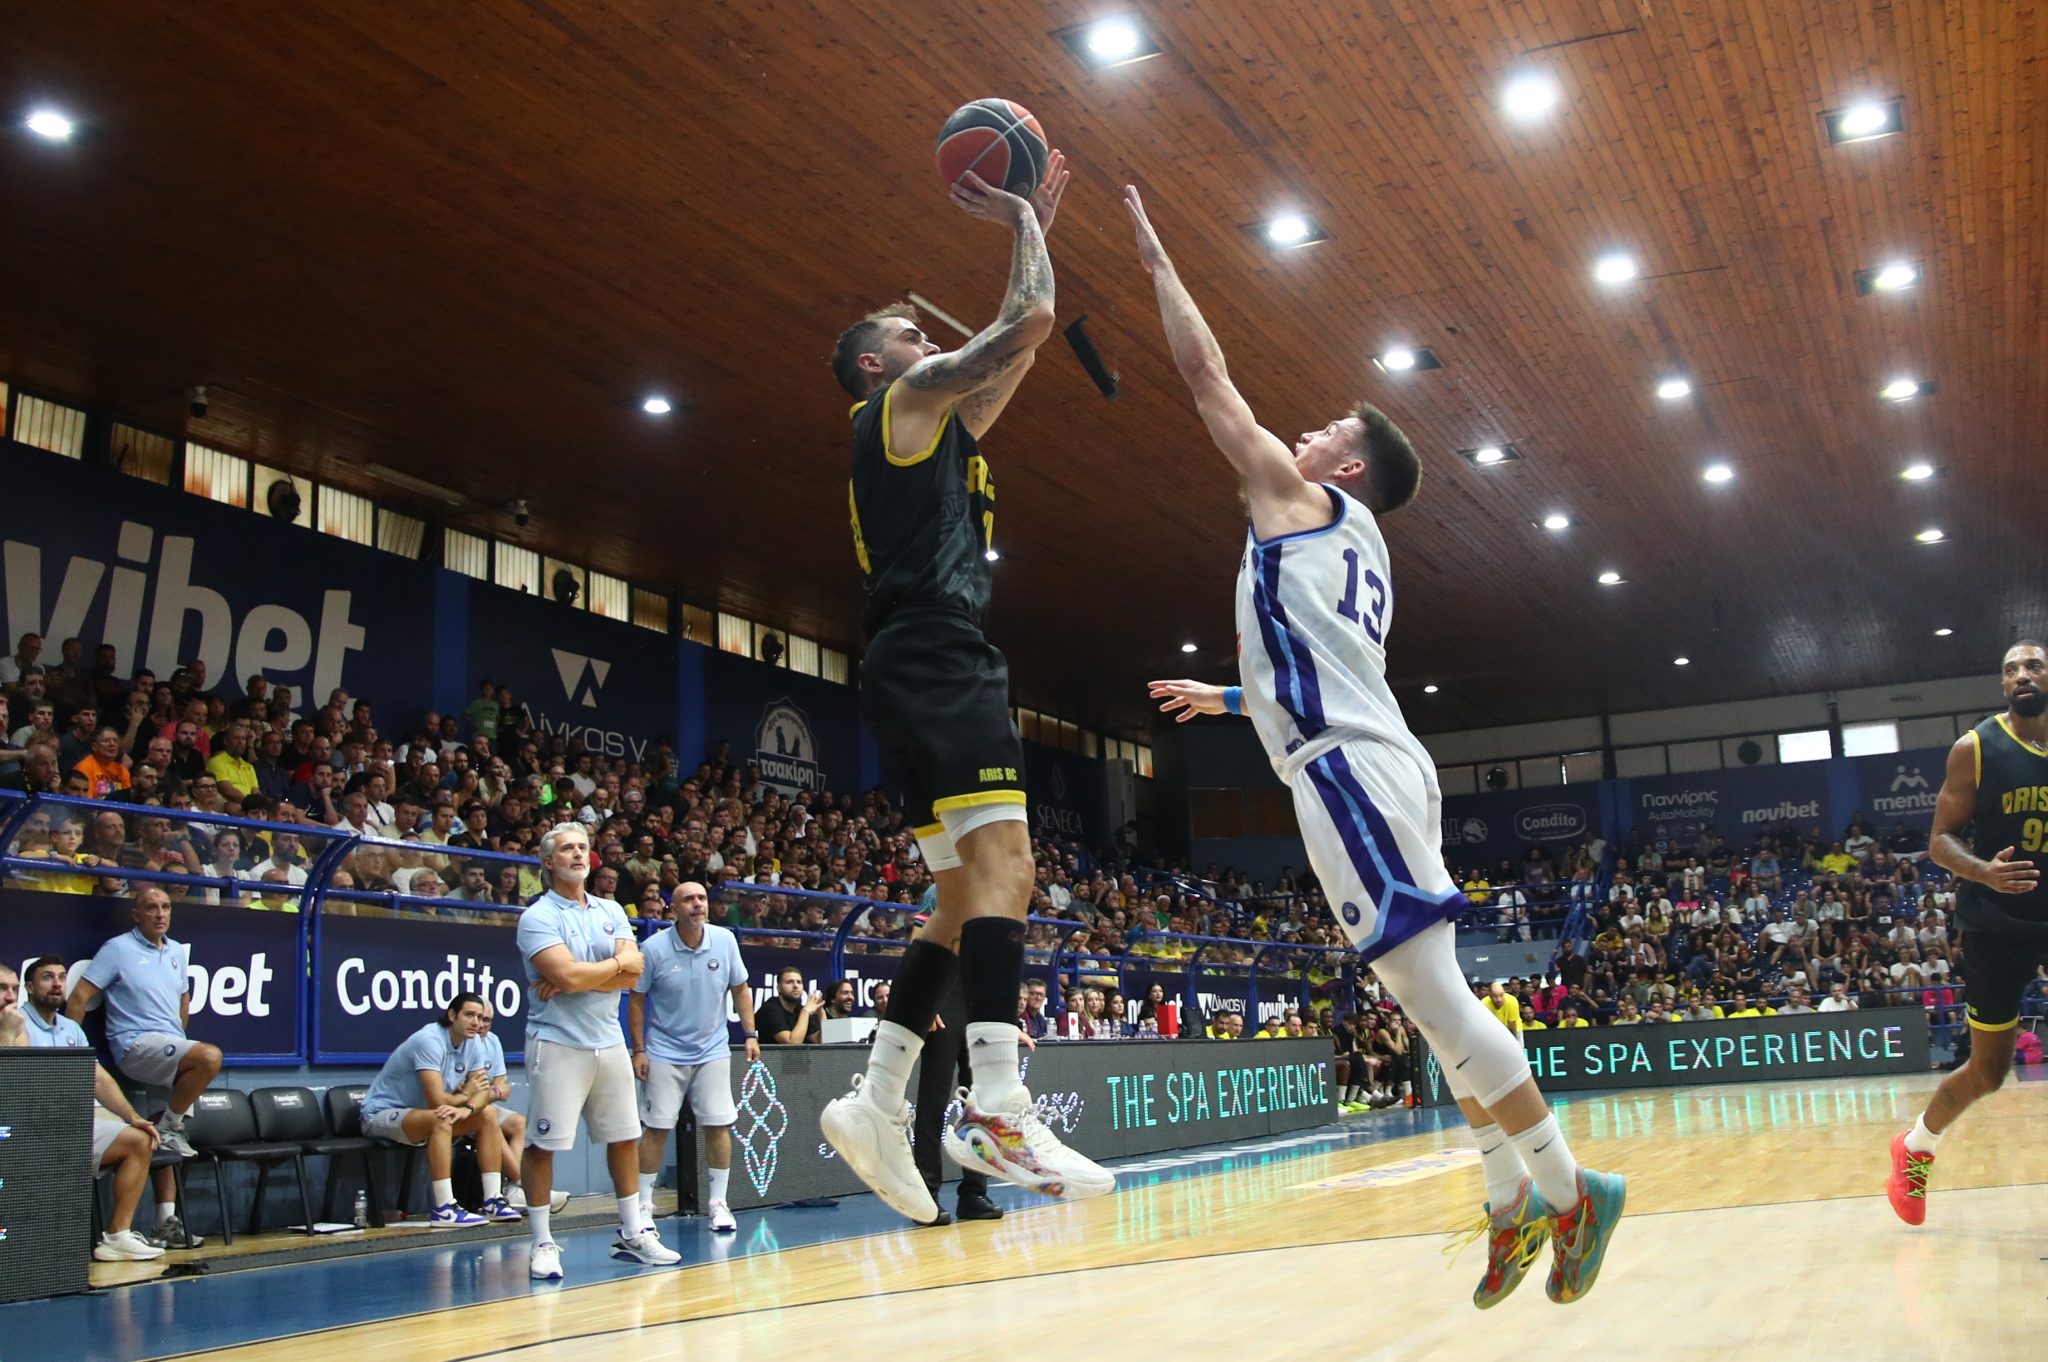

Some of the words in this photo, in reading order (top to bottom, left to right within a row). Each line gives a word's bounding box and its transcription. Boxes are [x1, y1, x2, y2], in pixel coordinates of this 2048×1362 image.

[1337, 548, 1386, 645] 13
[979, 767, 1004, 782] ARIS
[1005, 767, 1018, 781] BC
[1037, 804, 1084, 834] SENECA
[1522, 812, 1577, 831] Condito
[1742, 800, 1820, 823] novibet
[336, 954, 521, 1018] Condito
[1526, 1046, 1567, 1078] HE
[1584, 1042, 1653, 1075] SPA
[1668, 1026, 1904, 1071] EXPERIENCE
[1106, 1074, 1157, 1130] THE
[1166, 1071, 1210, 1123] SPA
[1217, 1062, 1329, 1118] EXPERIENCE
